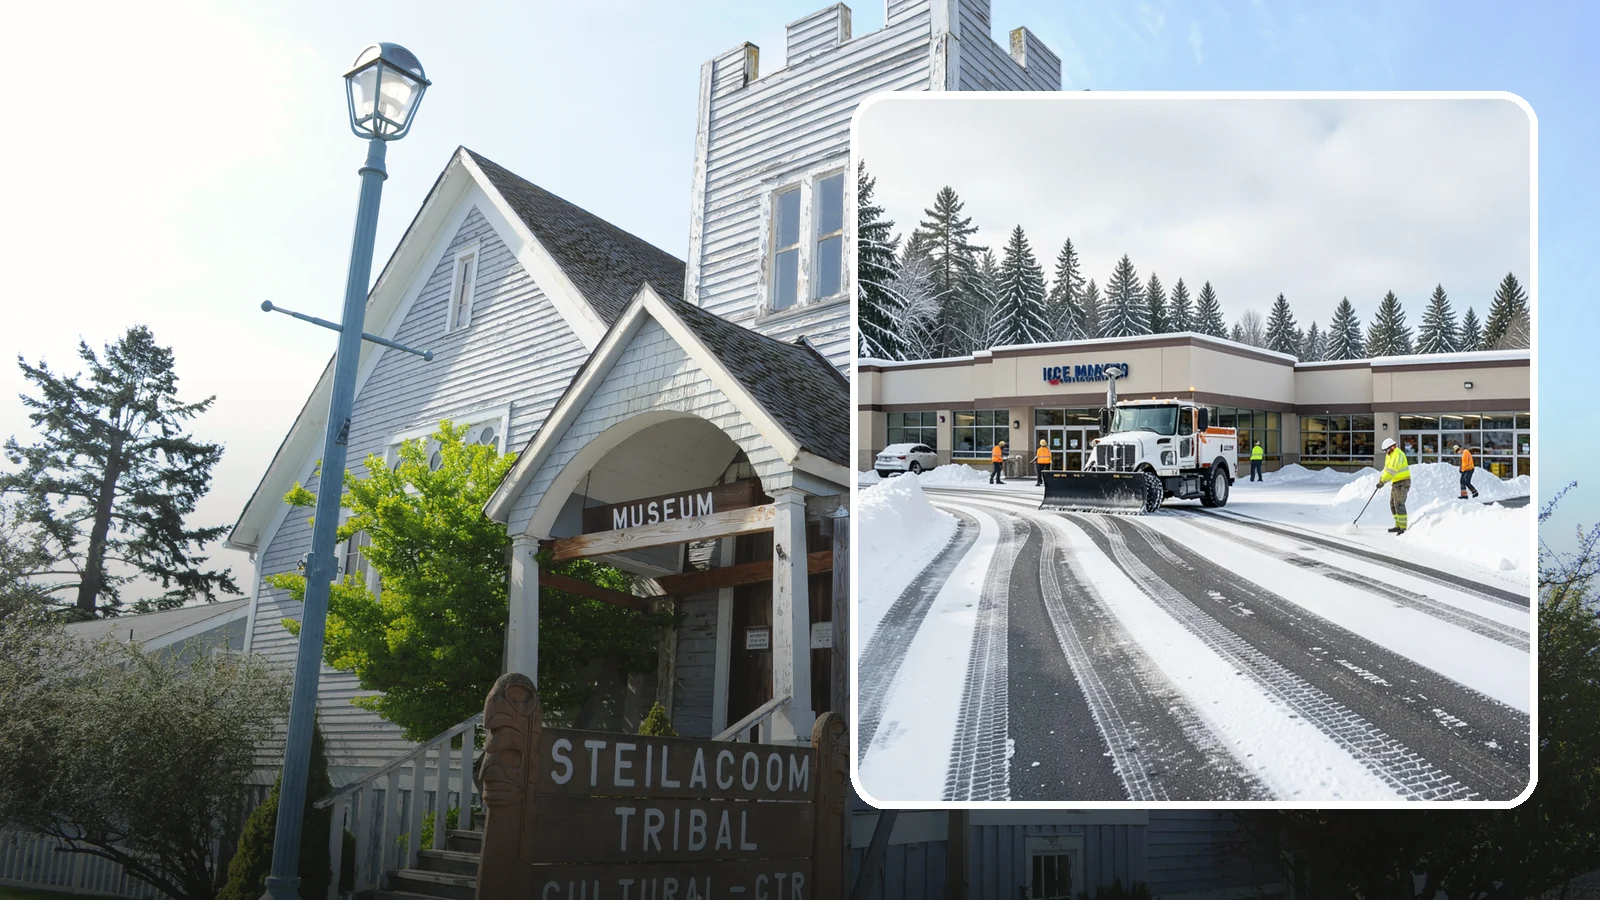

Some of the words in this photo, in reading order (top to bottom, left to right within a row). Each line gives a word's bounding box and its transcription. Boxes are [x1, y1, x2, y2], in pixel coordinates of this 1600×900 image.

[612, 491, 714, 531] MUSEUM
[550, 738, 809, 792] STEILACOOM
[615, 806, 757, 852] TRIBAL
